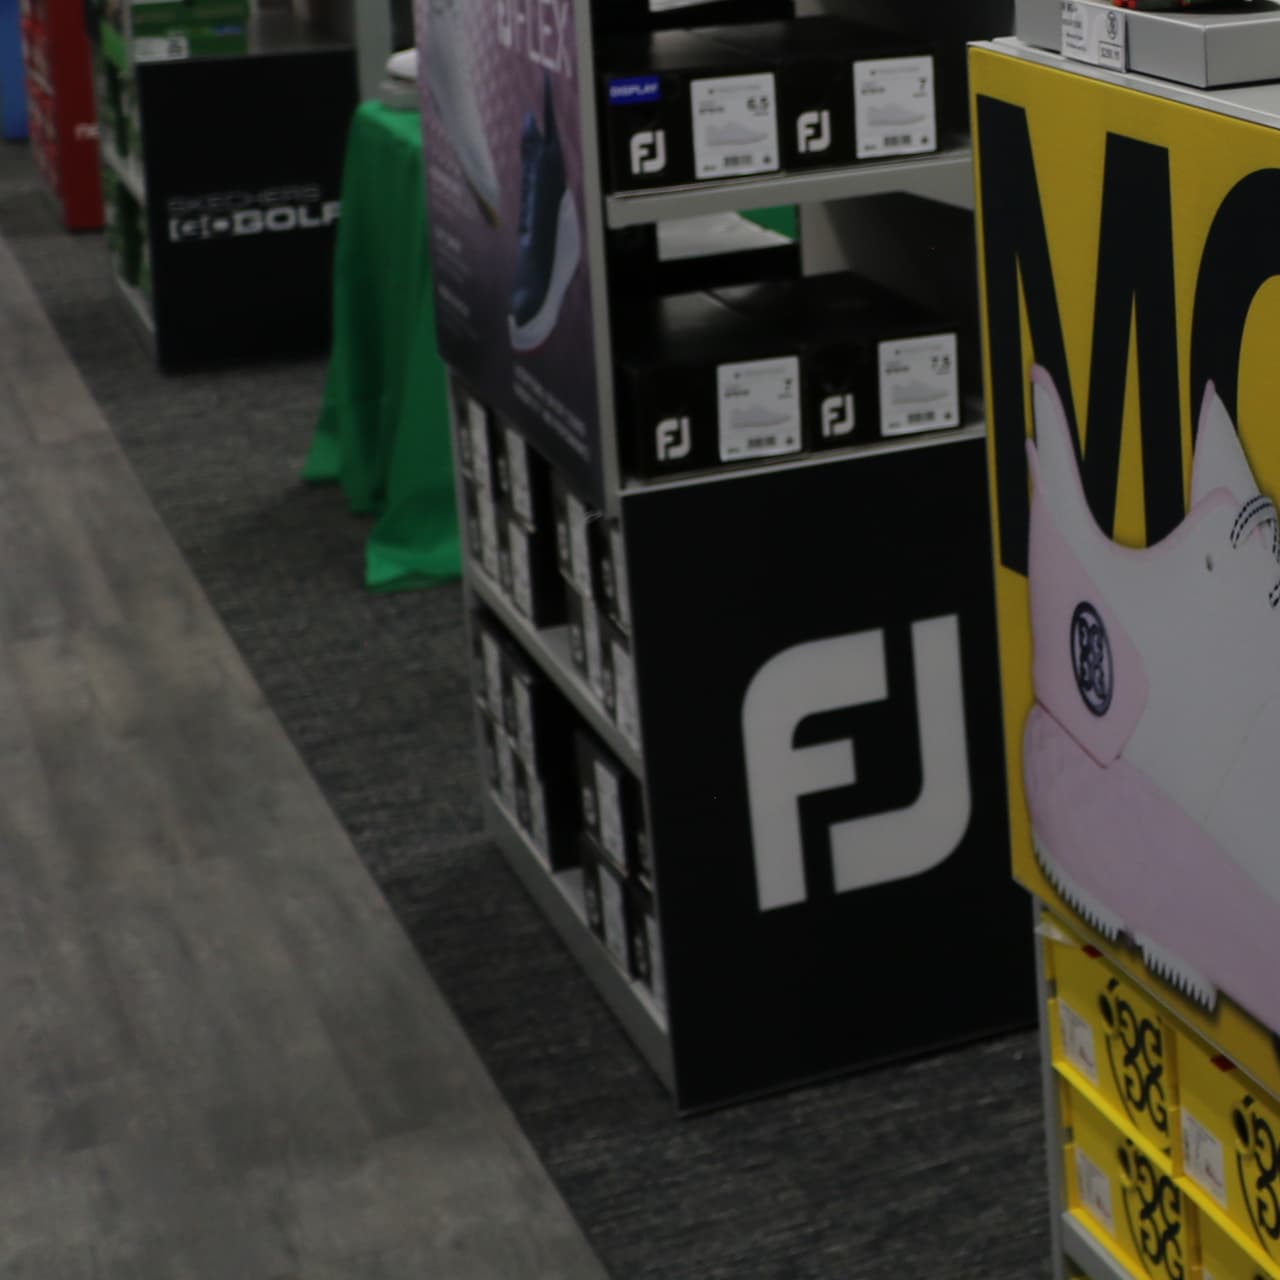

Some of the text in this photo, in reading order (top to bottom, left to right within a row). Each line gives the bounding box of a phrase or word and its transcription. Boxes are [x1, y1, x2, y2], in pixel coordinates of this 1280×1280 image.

[610, 82, 659, 98] DISPLAY
[630, 130, 667, 175] FJ
[797, 109, 831, 153] FJ
[821, 393, 855, 438] FJ
[655, 417, 691, 461] FJ
[742, 614, 972, 912] FJ
